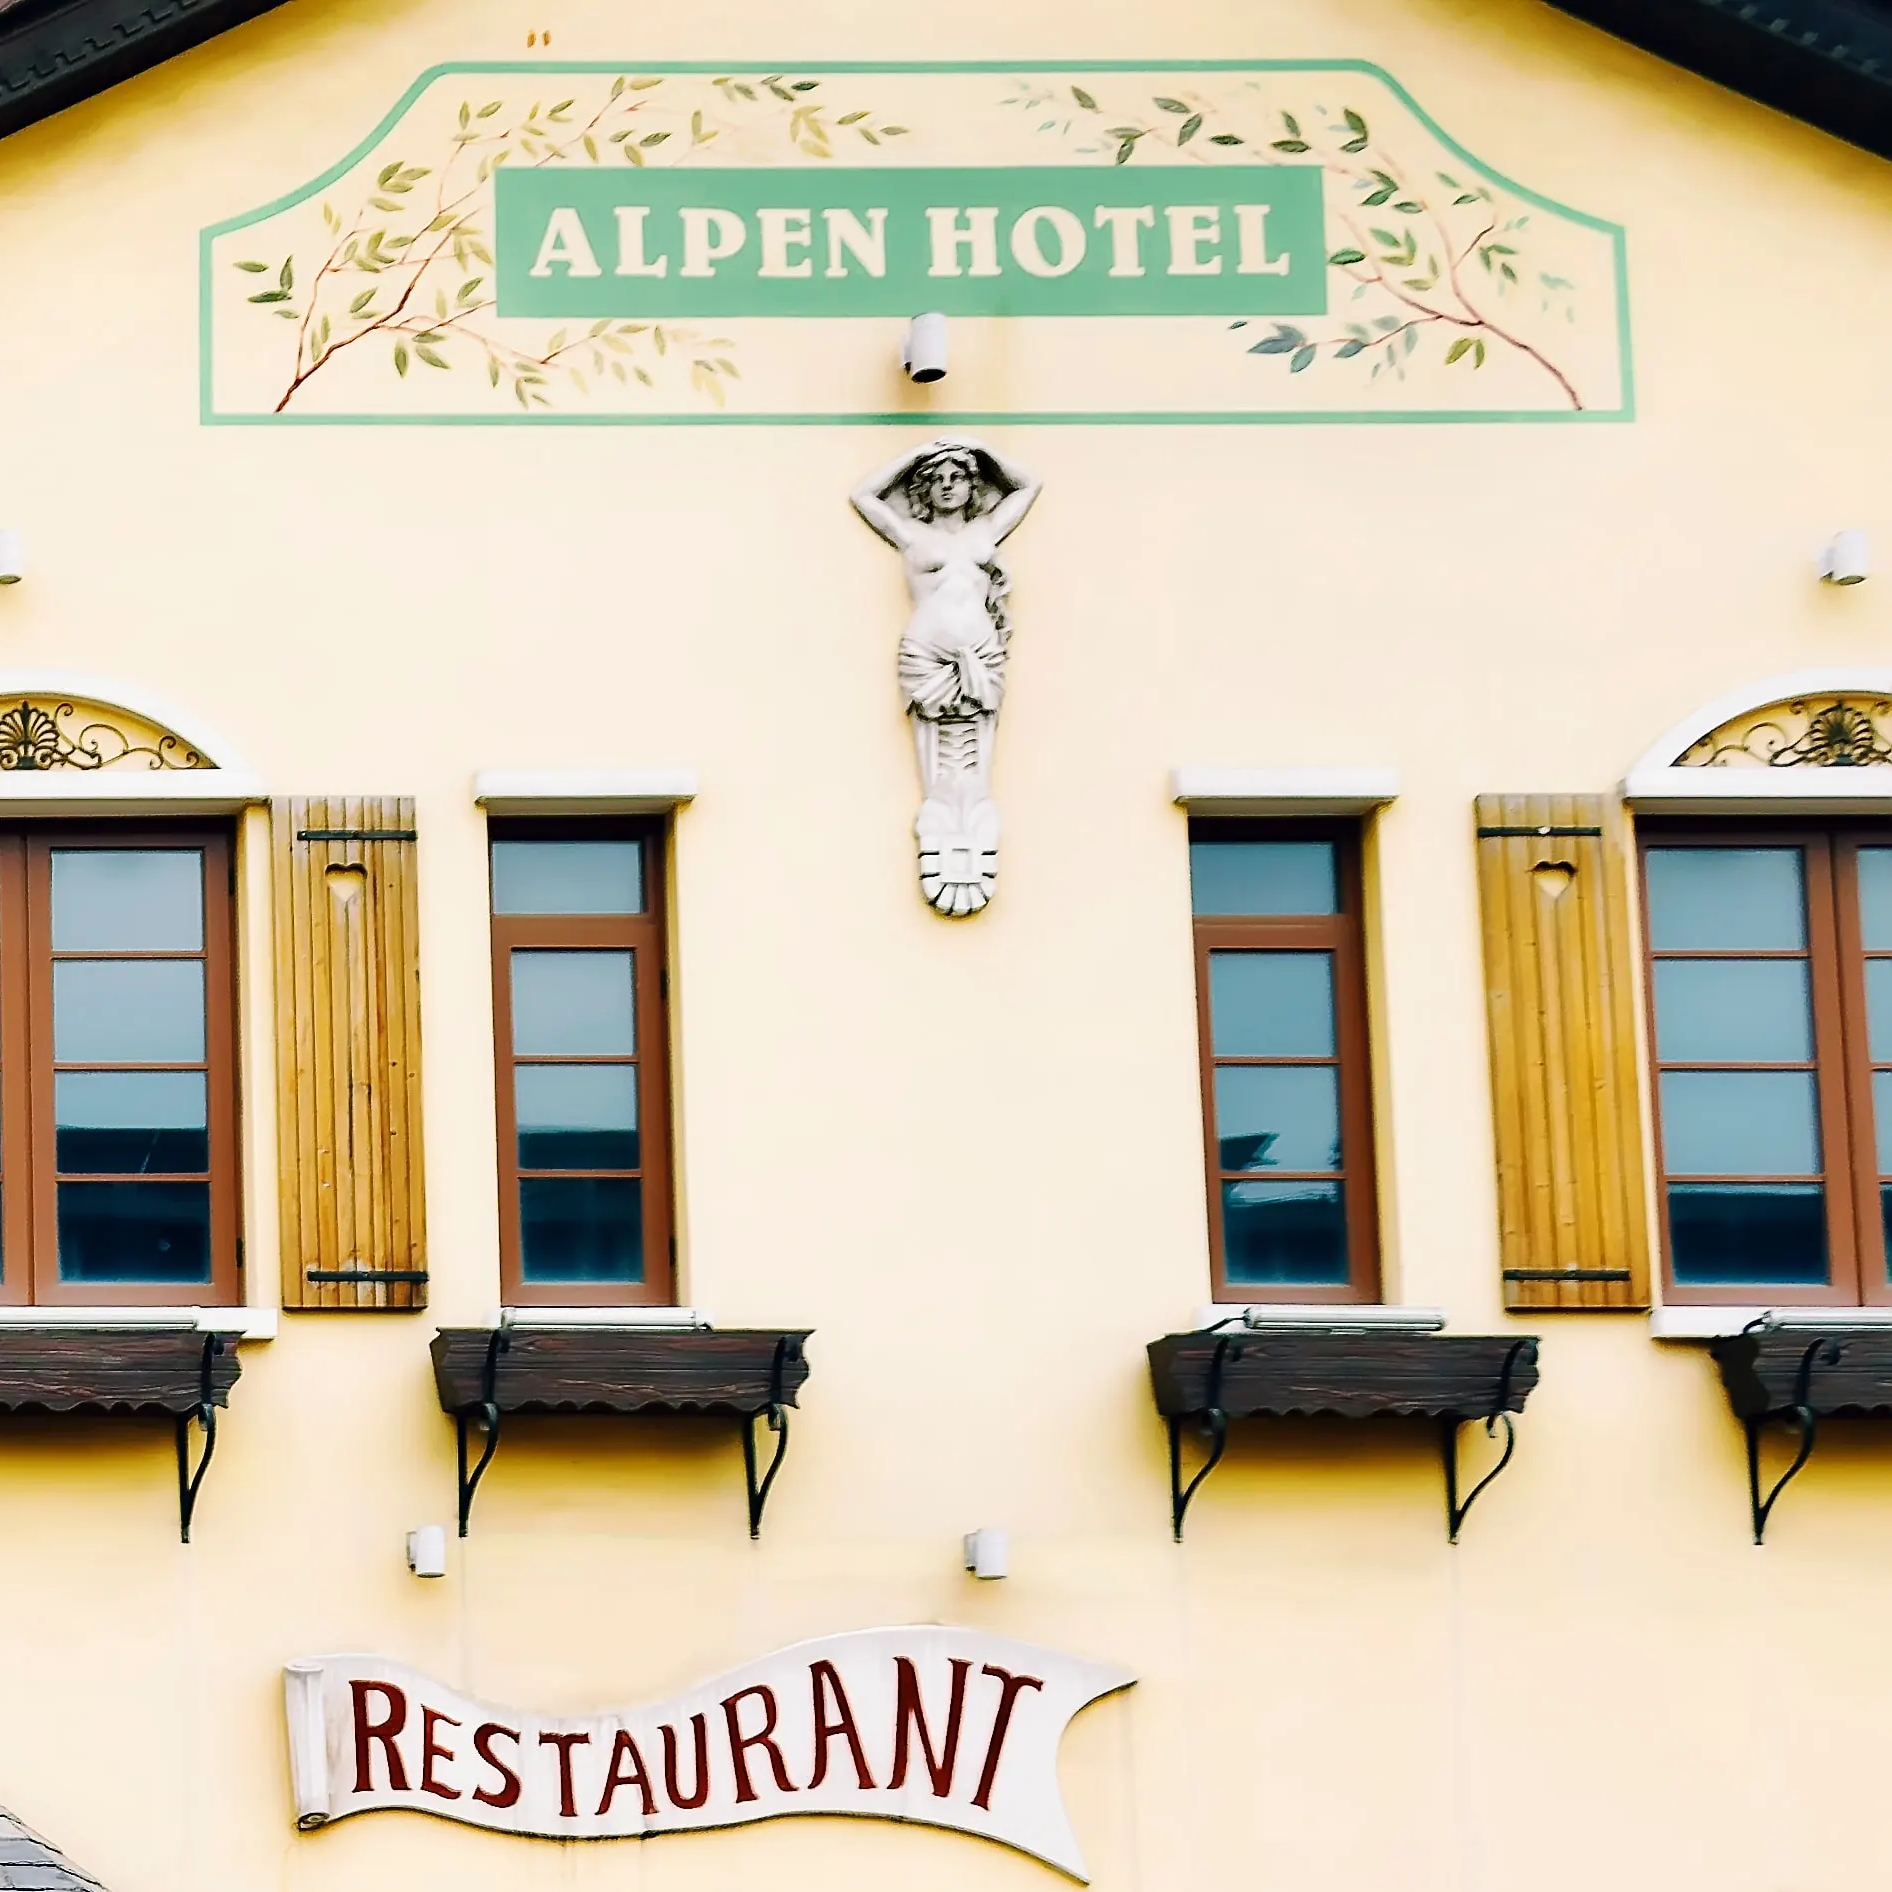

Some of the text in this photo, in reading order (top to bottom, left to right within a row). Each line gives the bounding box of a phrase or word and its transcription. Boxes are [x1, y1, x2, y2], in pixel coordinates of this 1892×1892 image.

[528, 204, 1291, 279] ALPEN HOTEL
[347, 1656, 1045, 1817] RESTAURANT
